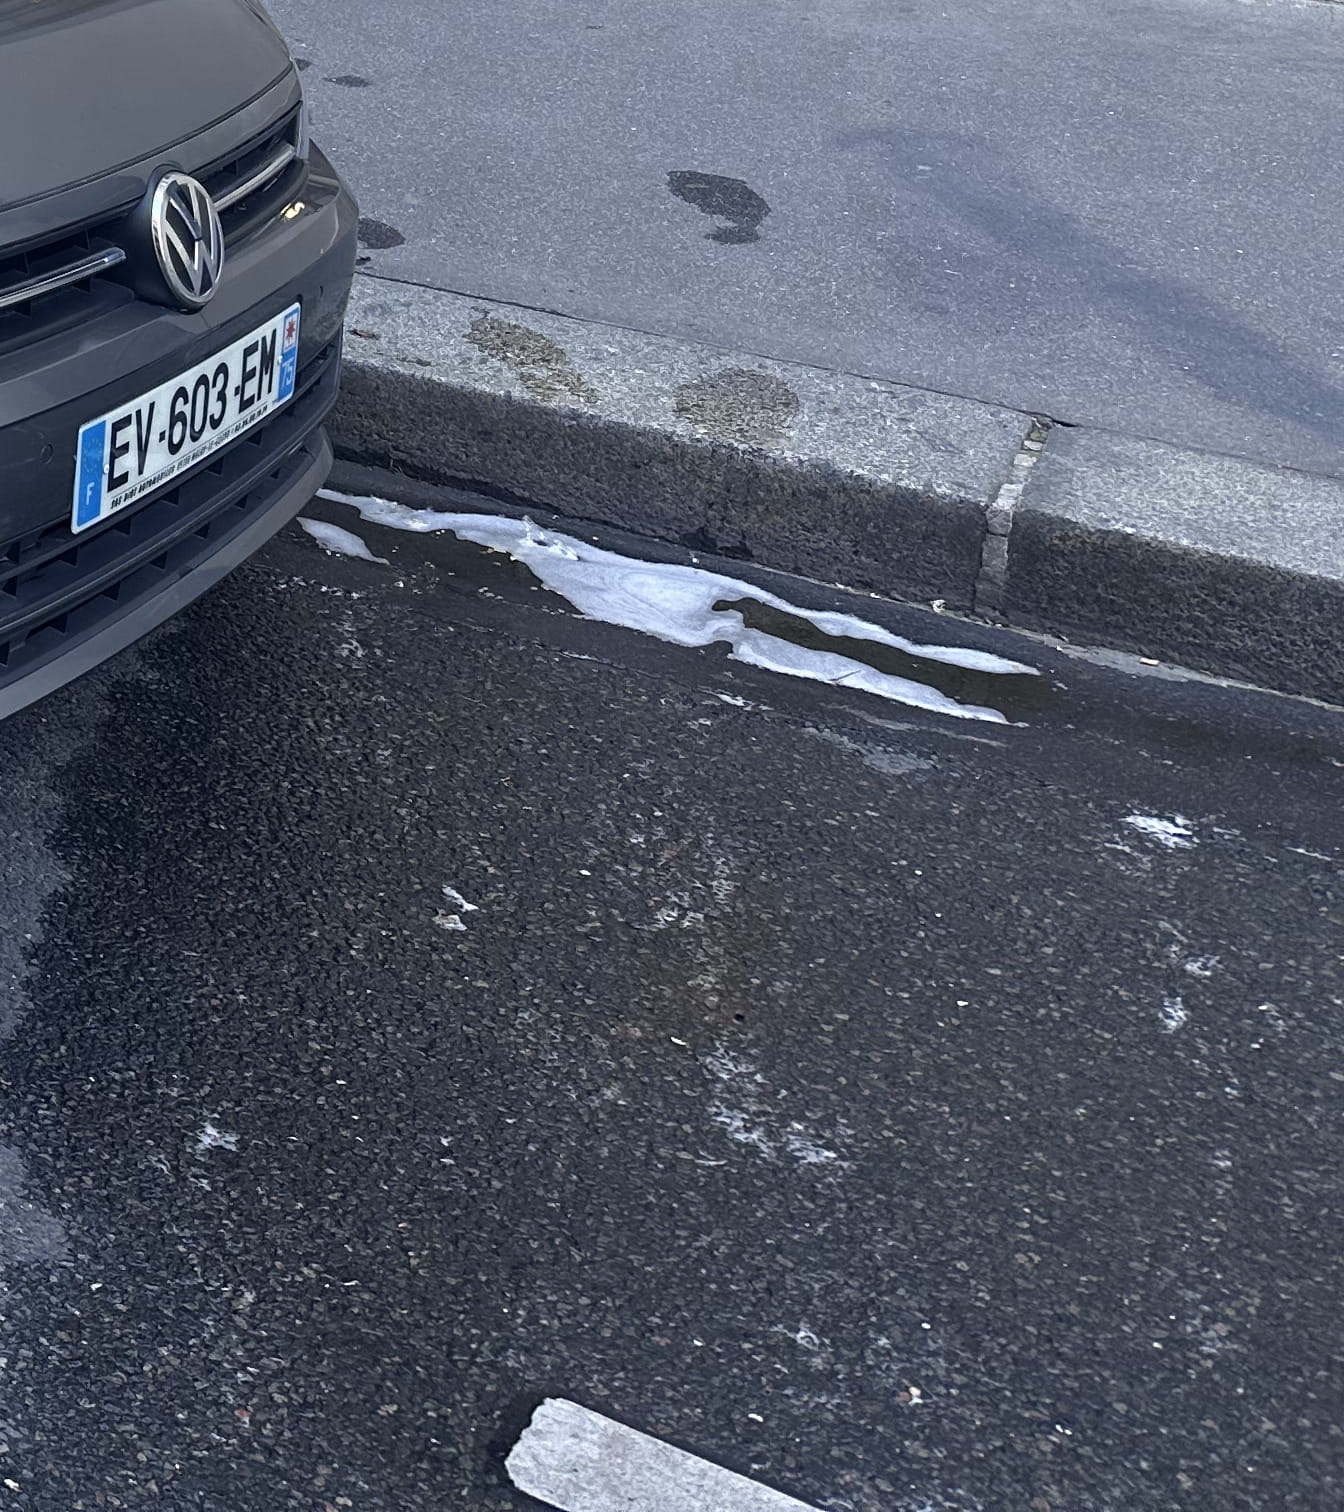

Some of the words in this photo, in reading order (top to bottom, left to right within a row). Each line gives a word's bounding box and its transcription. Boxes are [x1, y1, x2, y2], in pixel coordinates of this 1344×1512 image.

[282, 358, 295, 390] 75
[107, 328, 278, 492] EV-603-EM
[85, 482, 95, 505] F
